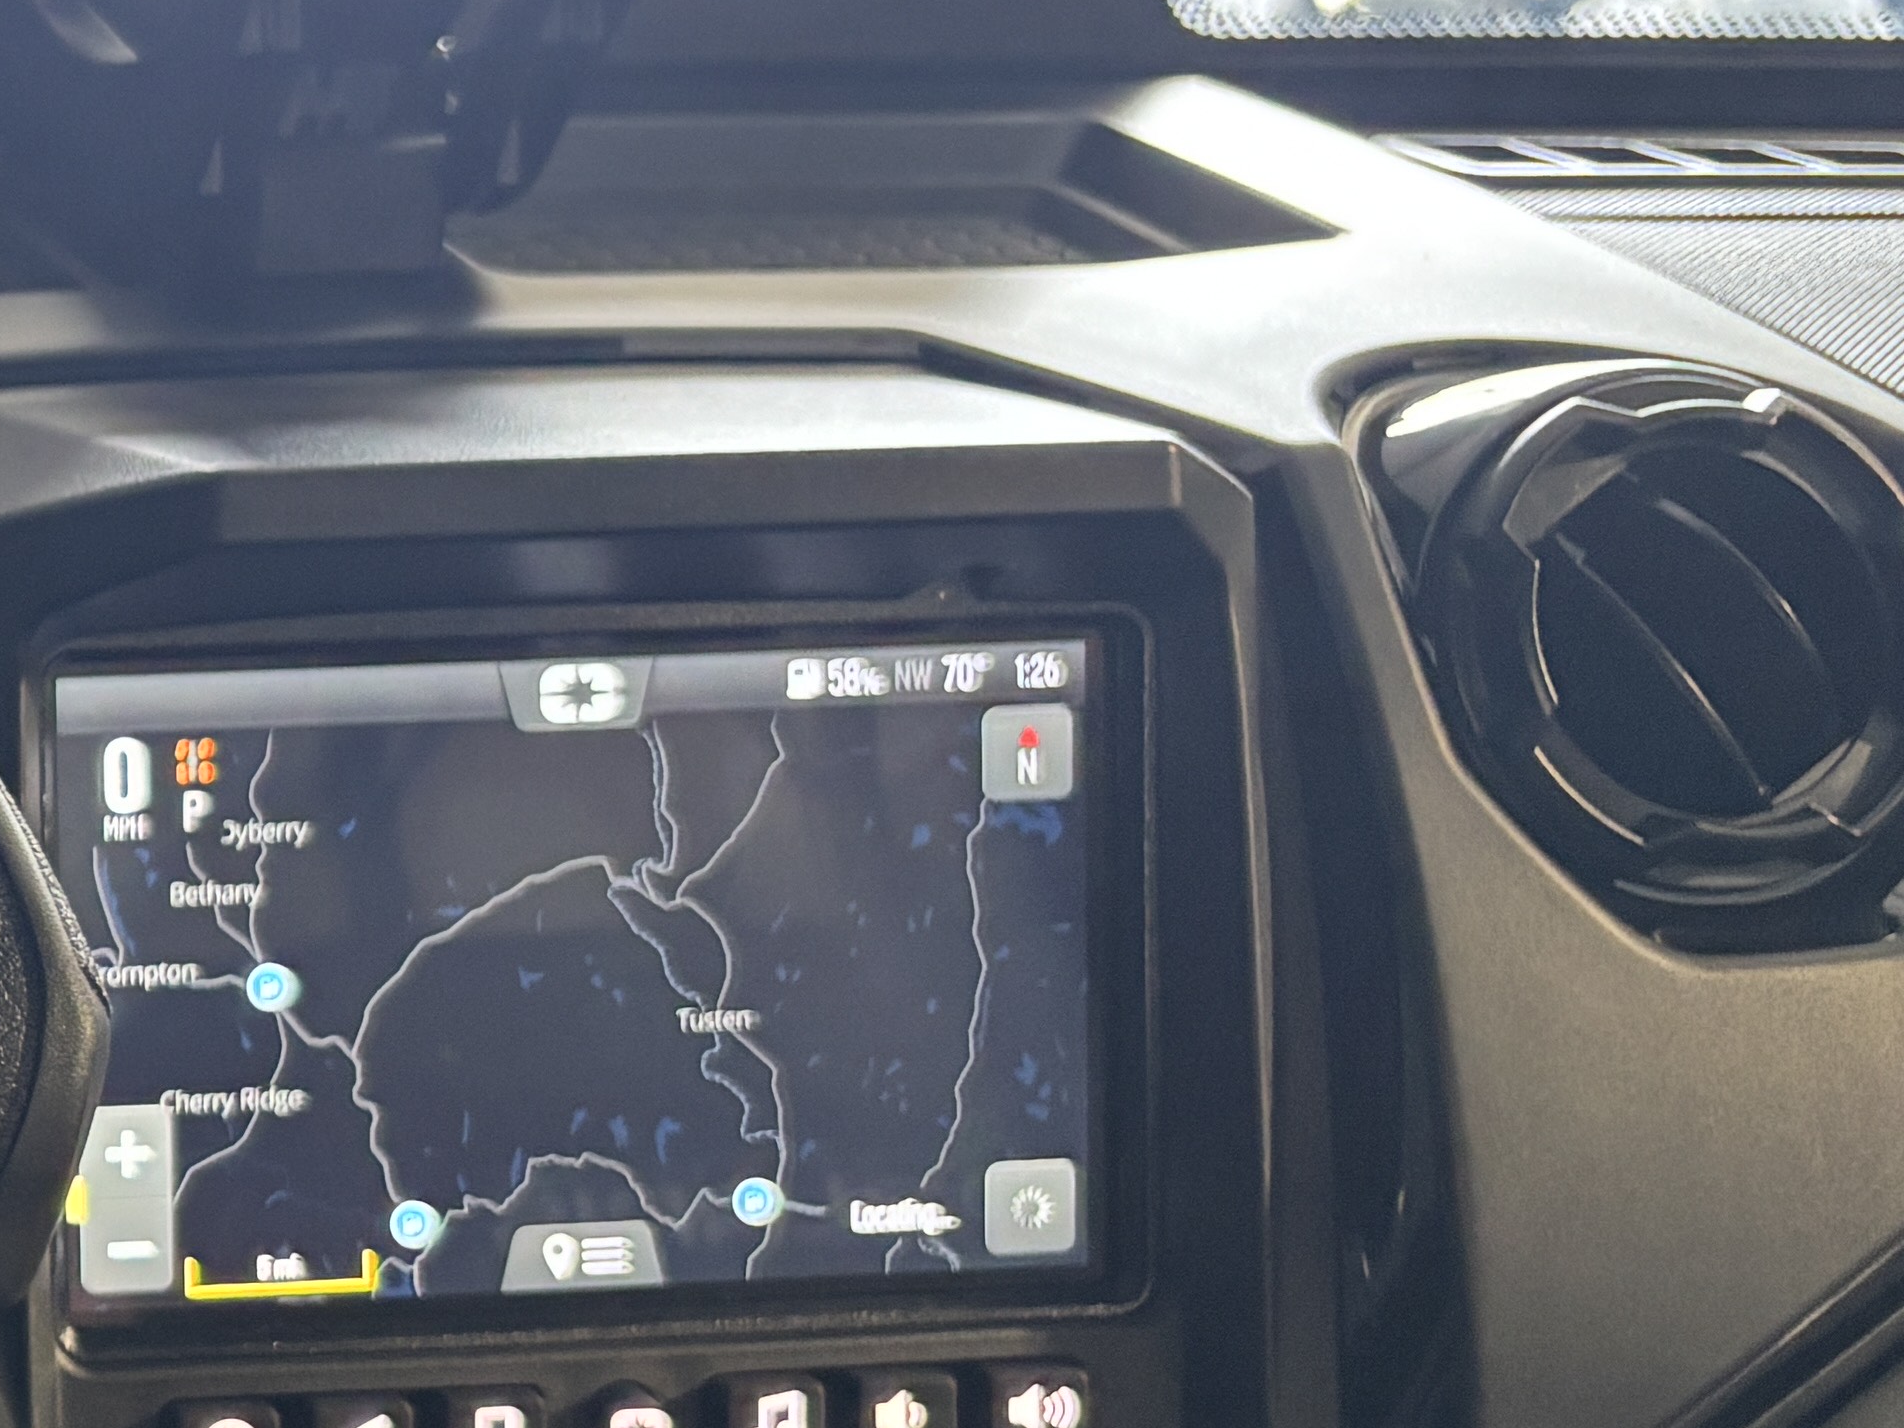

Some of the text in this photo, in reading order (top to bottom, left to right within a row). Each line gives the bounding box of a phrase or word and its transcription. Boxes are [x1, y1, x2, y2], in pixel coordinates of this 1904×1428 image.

[894, 657, 933, 692] NW
[1014, 651, 1069, 689] 1:26
[103, 736, 152, 814] 0
[1016, 746, 1038, 785] N
[103, 815, 153, 842] MPH
[182, 789, 213, 833] P
[169, 880, 263, 909] Bethany
[97, 962, 200, 992] rompton
[159, 1086, 311, 1120] Cherry Ridge
